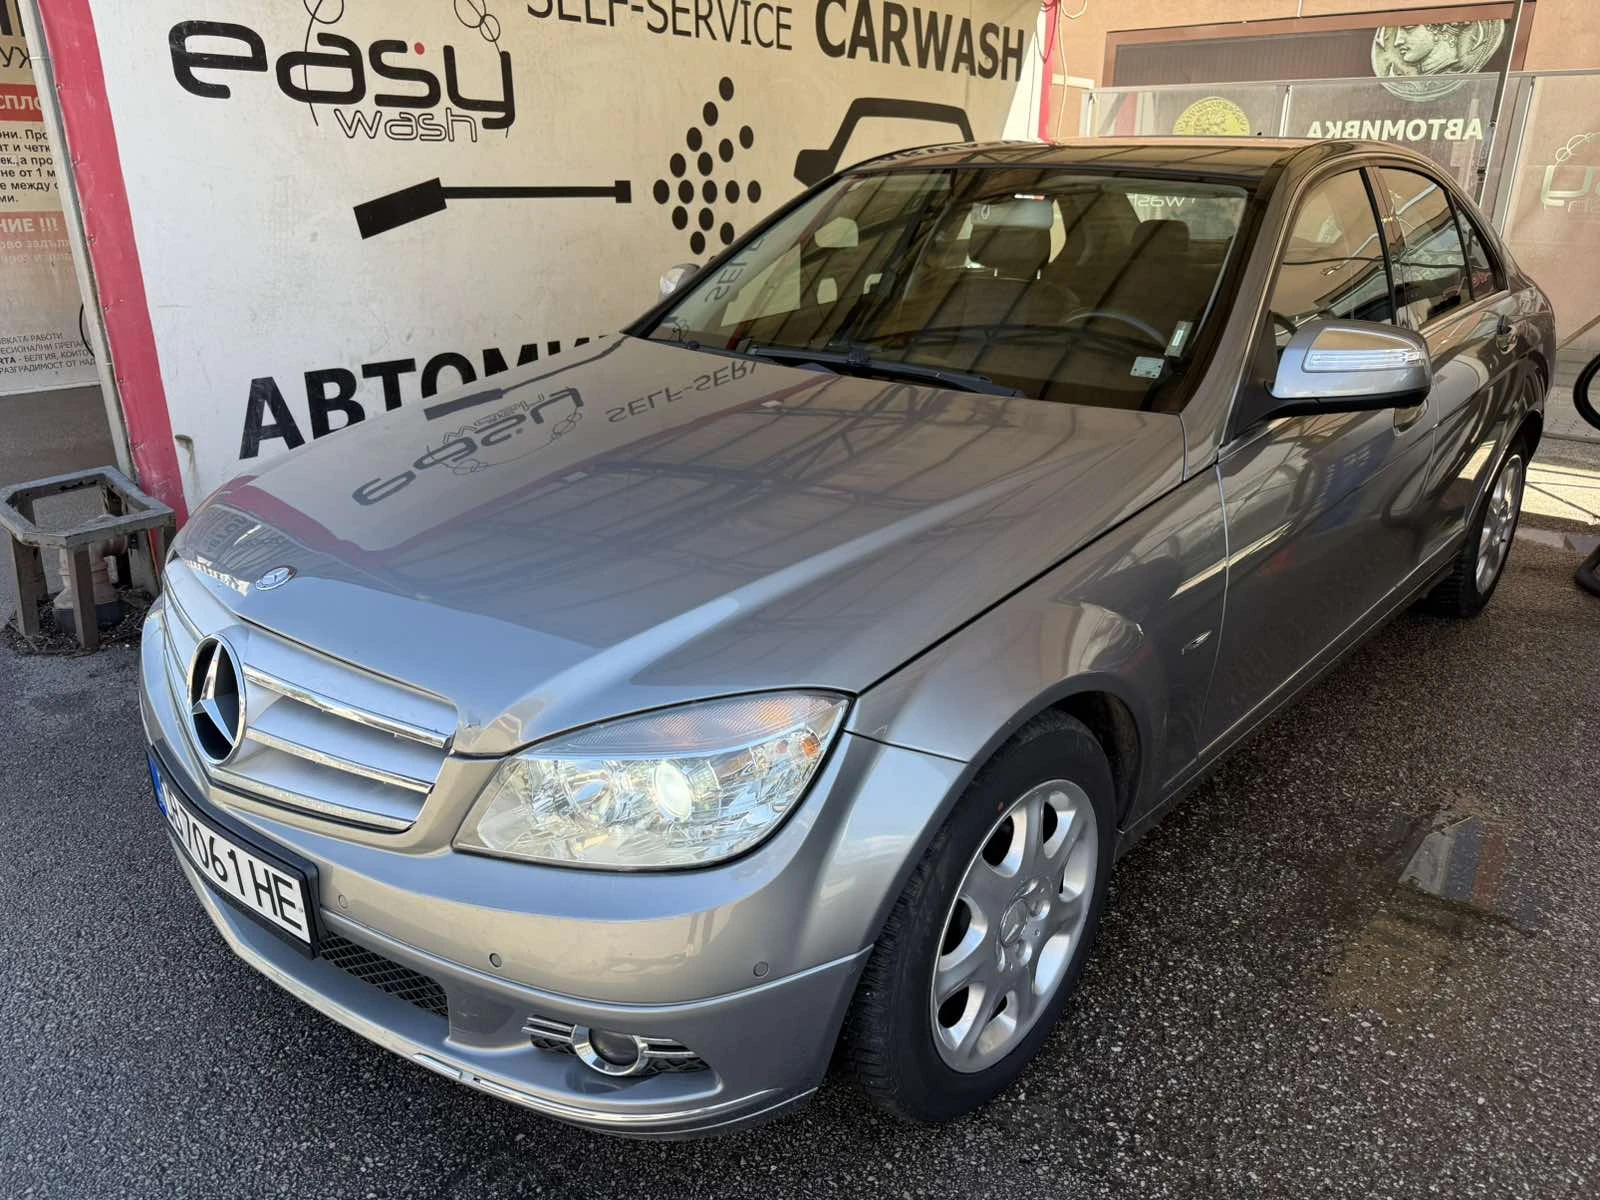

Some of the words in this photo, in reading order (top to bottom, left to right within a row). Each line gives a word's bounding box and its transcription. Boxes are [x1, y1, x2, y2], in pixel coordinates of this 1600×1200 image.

[816, 0, 1025, 82] CARWASH
[169, 20, 516, 129] easy
[333, 107, 478, 142] wash
[11, 183, 50, 192] между
[36, 168, 42, 177] 1
